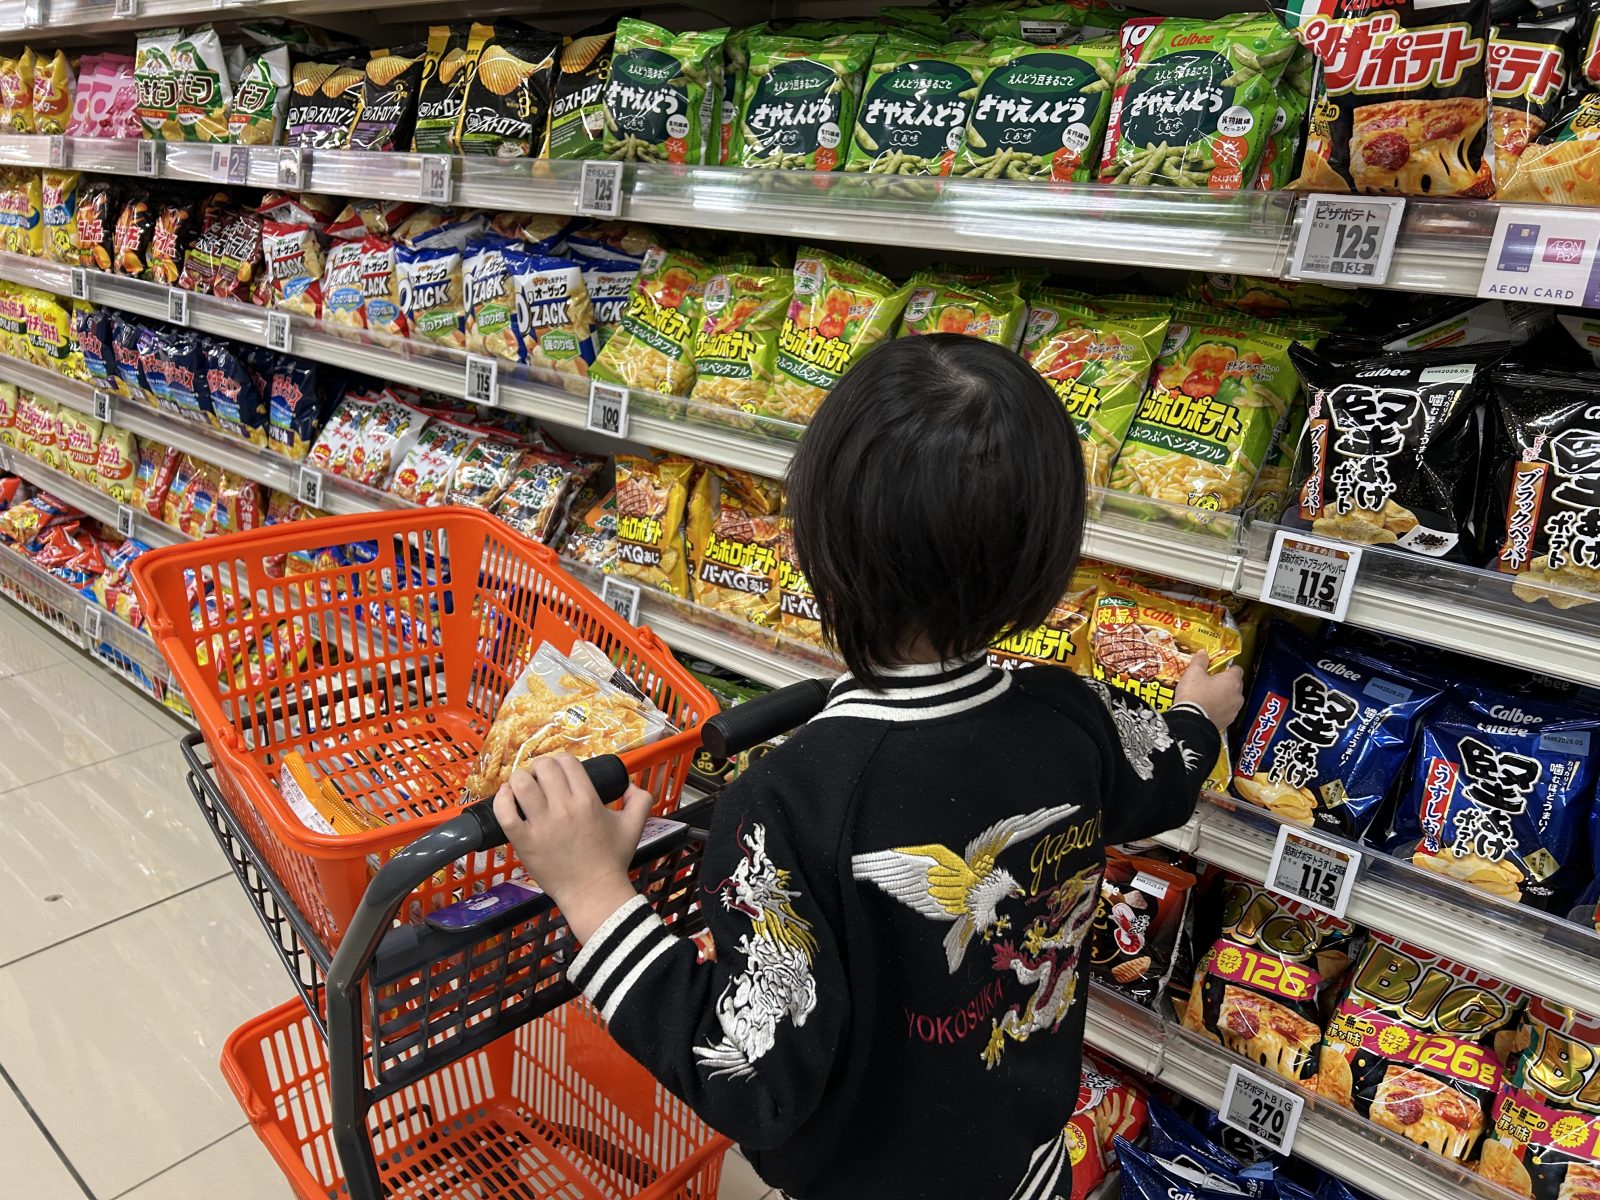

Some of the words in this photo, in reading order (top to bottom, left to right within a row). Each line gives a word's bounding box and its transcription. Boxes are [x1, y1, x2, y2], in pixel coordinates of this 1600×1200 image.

[1121, 25, 1156, 49] 10
[1170, 33, 1214, 48] Calbee
[1007, 73, 1075, 87] えんどう豆まるごと
[606, 80, 680, 115] さやえんどう
[975, 93, 1087, 124] さやえんどう
[1130, 87, 1224, 117] さやえんどう
[752, 98, 834, 127] さやえんどう
[865, 99, 967, 127] さやえんどう
[1005, 132, 1032, 143] しお味
[431, 169, 445, 190] 125
[595, 178, 613, 201] 125
[1315, 207, 1376, 223] ピザポテト
[1333, 224, 1380, 260] 125
[414, 267, 447, 283] オーザック
[1341, 262, 1365, 274] 135
[534, 283, 568, 298] オーザック
[1489, 284, 1528, 297] AEON
[1533, 287, 1575, 300] CARD
[475, 372, 491, 393] 115
[1355, 367, 1412, 378] Calbee
[602, 405, 619, 424] 100
[306, 481, 317, 498] 95
[1502, 467, 1545, 570] ブラックペッパー
[1295, 542, 1337, 559] おすすめ品
[1545, 511, 1574, 569] ポテト
[705, 532, 778, 576] サッポロポテト
[701, 564, 770, 594] バーベQあじ
[1299, 568, 1338, 601] 115
[1097, 607, 1134, 625] 肉の旨み
[1142, 606, 1192, 632] Calbee
[1317, 659, 1362, 682] Calbee
[1239, 697, 1281, 777] うすしお味
[1421, 763, 1451, 853] うすしお味
[1453, 807, 1480, 858] ポテト
[1302, 863, 1338, 897] 115
[1354, 943, 1506, 1034] BIG
[903, 977, 1005, 1046] YOKOSUKA
[1379, 1040, 1403, 1055] サイズ
[1383, 1030, 1407, 1044] ビッグ
[1407, 1034, 1498, 1085] 126g
[1248, 1098, 1285, 1133] 270
[1498, 1113, 1531, 1143] 罪な味
